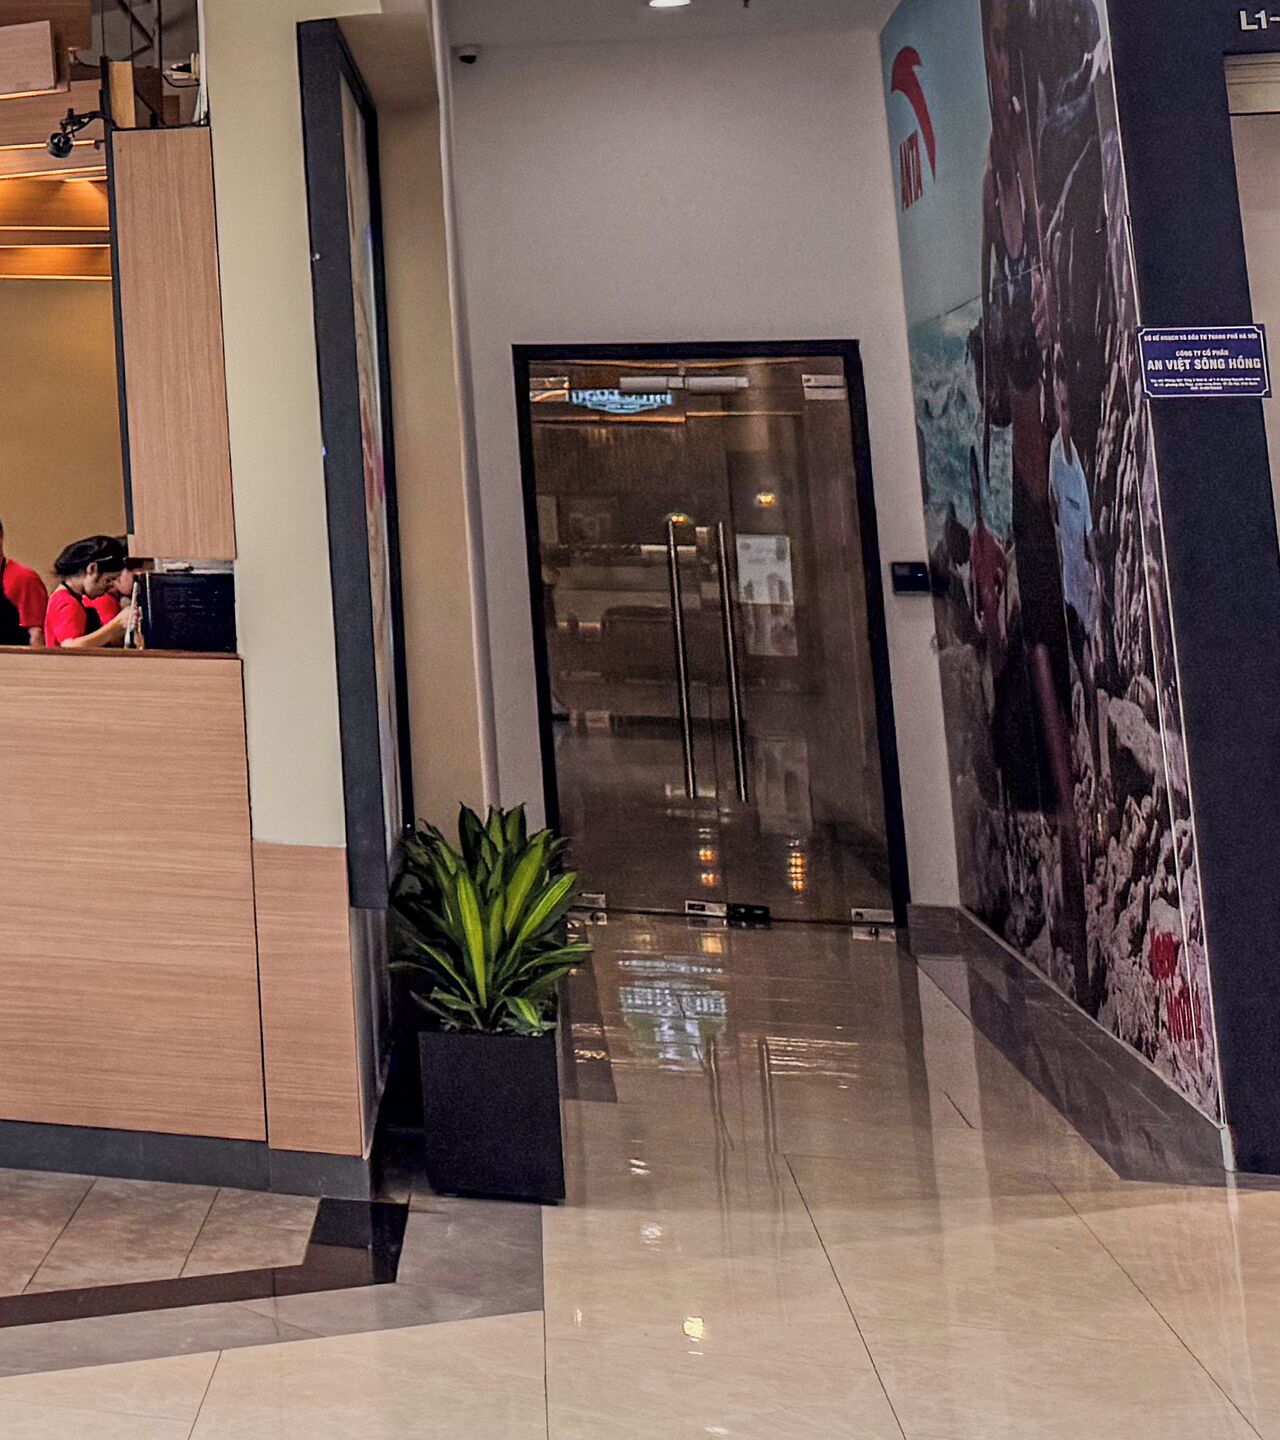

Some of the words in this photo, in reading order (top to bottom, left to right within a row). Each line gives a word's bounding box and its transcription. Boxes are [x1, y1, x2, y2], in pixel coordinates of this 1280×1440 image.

[1176, 349, 1193, 357] CÔNG
[1147, 359, 1163, 371] AN
[1165, 357, 1191, 372] VIỆT
[1194, 357, 1225, 370] SÔNG
